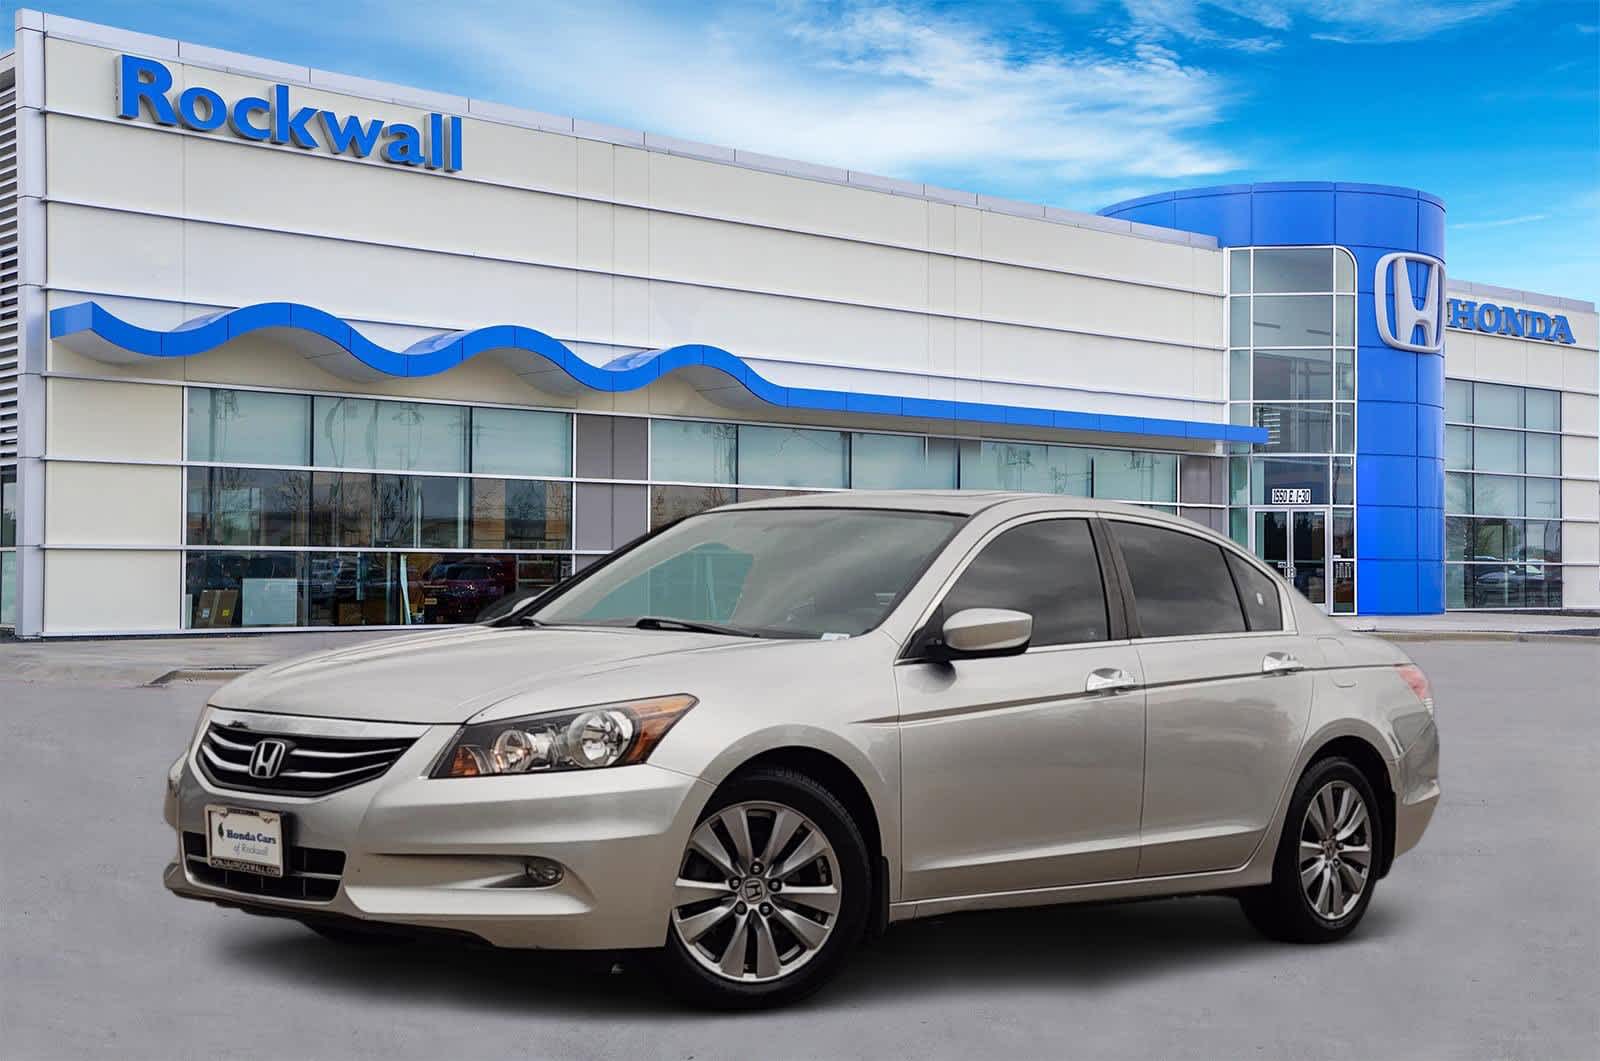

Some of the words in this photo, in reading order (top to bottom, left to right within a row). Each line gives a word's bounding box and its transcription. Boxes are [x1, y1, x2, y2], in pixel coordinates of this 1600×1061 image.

[116, 54, 463, 172] Rockwall
[1447, 298, 1577, 344] HONDA
[226, 830, 256, 842] Honda
[257, 834, 277, 845] Cars
